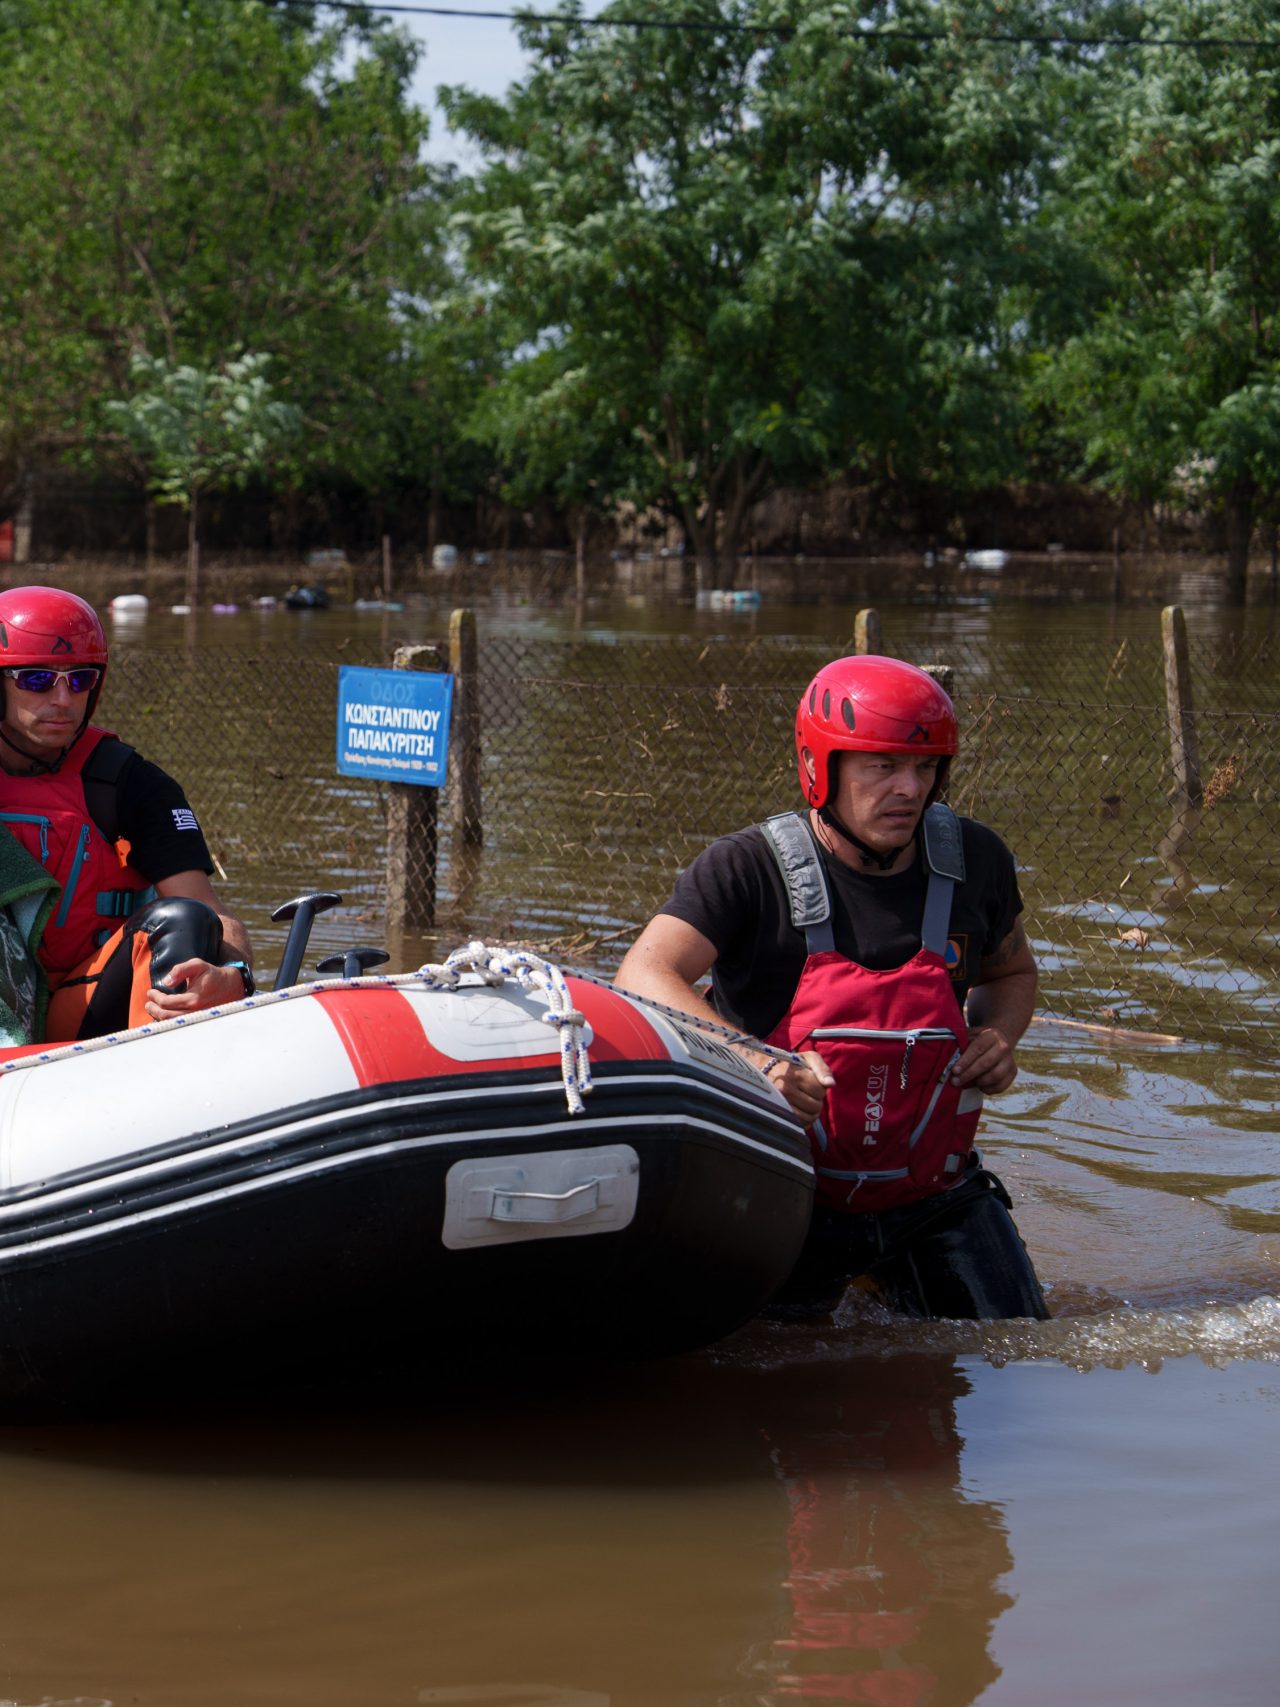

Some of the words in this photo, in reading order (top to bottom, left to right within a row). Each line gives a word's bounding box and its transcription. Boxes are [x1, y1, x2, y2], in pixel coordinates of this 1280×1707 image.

[370, 682, 416, 704] ΟΔΟΣ
[345, 702, 441, 732] ΚΩΝΣΤΑΝΤΙΝΟΥ
[348, 728, 435, 757] ΠΑΠΑΚΥΡΙΤΣΗ
[867, 1064, 885, 1089] UK
[863, 1092, 883, 1145] PEAK
